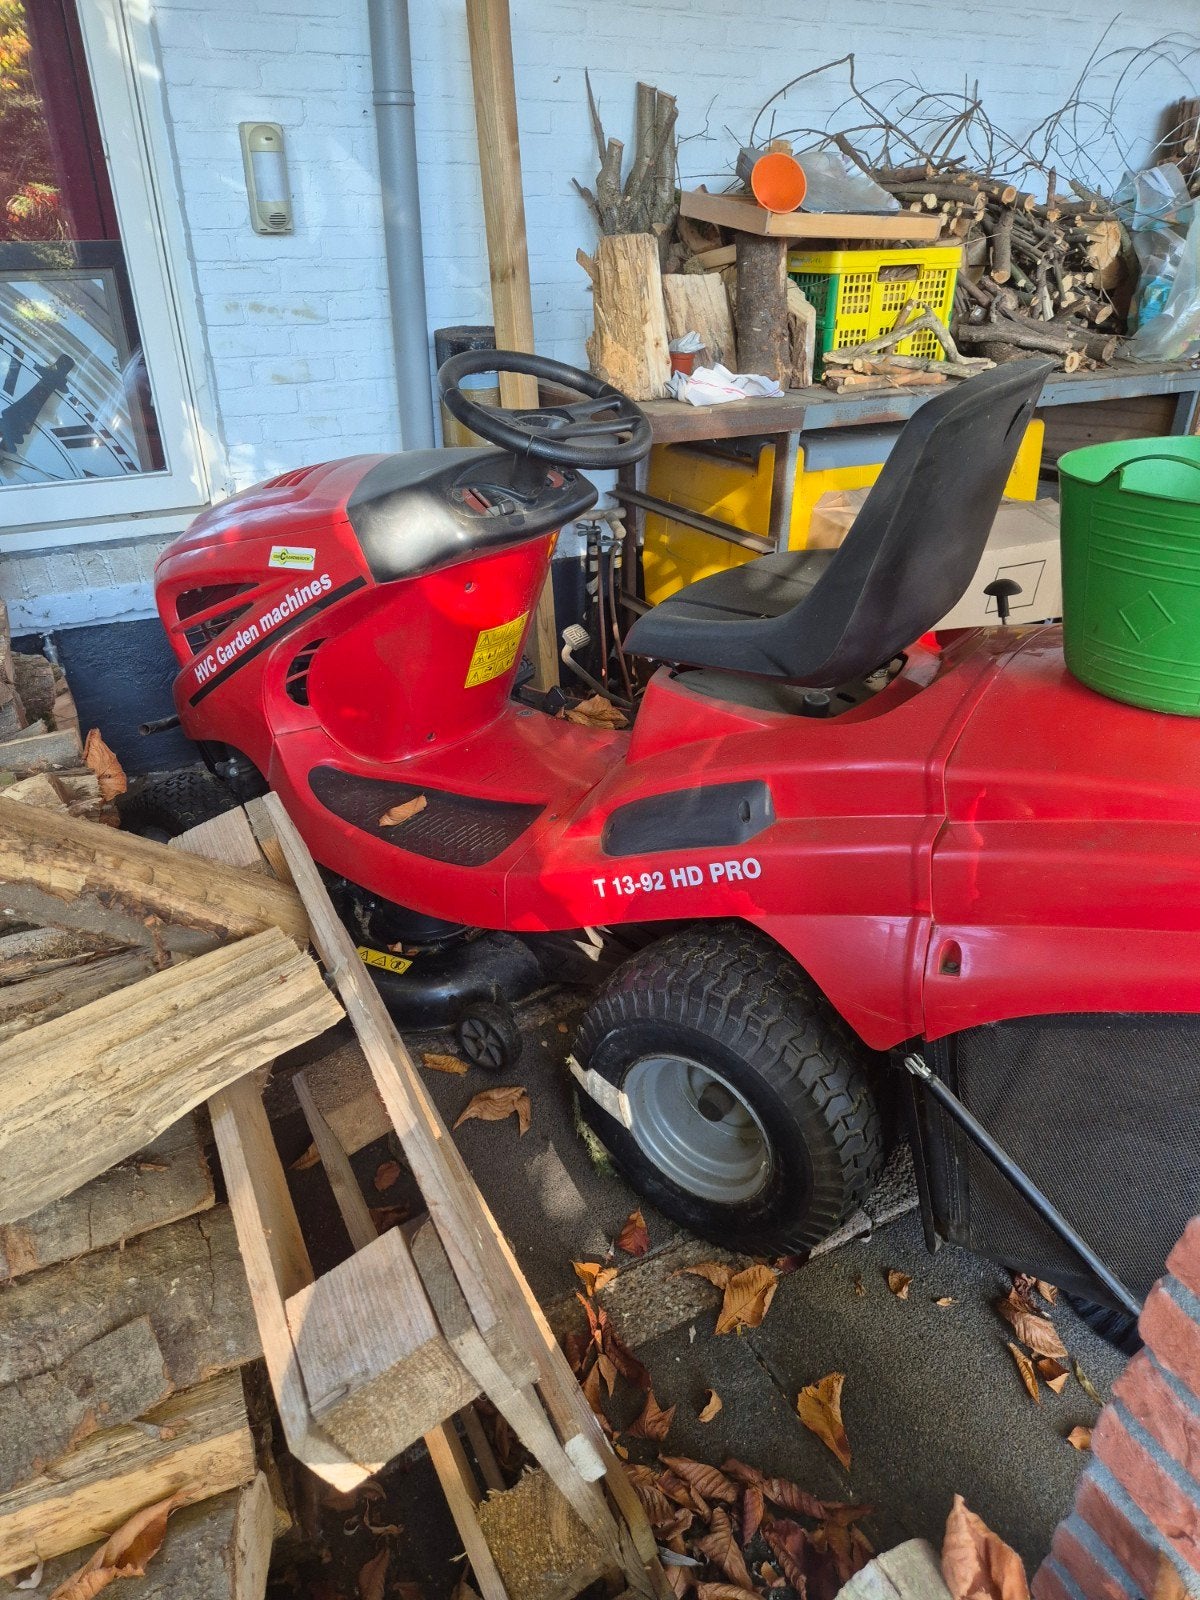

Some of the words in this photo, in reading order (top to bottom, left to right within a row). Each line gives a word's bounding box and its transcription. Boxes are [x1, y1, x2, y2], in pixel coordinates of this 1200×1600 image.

[194, 654, 217, 684] HVC
[216, 624, 260, 665] Garden
[259, 573, 332, 632] machines
[593, 878, 606, 898] T
[612, 871, 667, 896] 13-92
[669, 865, 704, 888] HD
[708, 857, 762, 883] PRO
